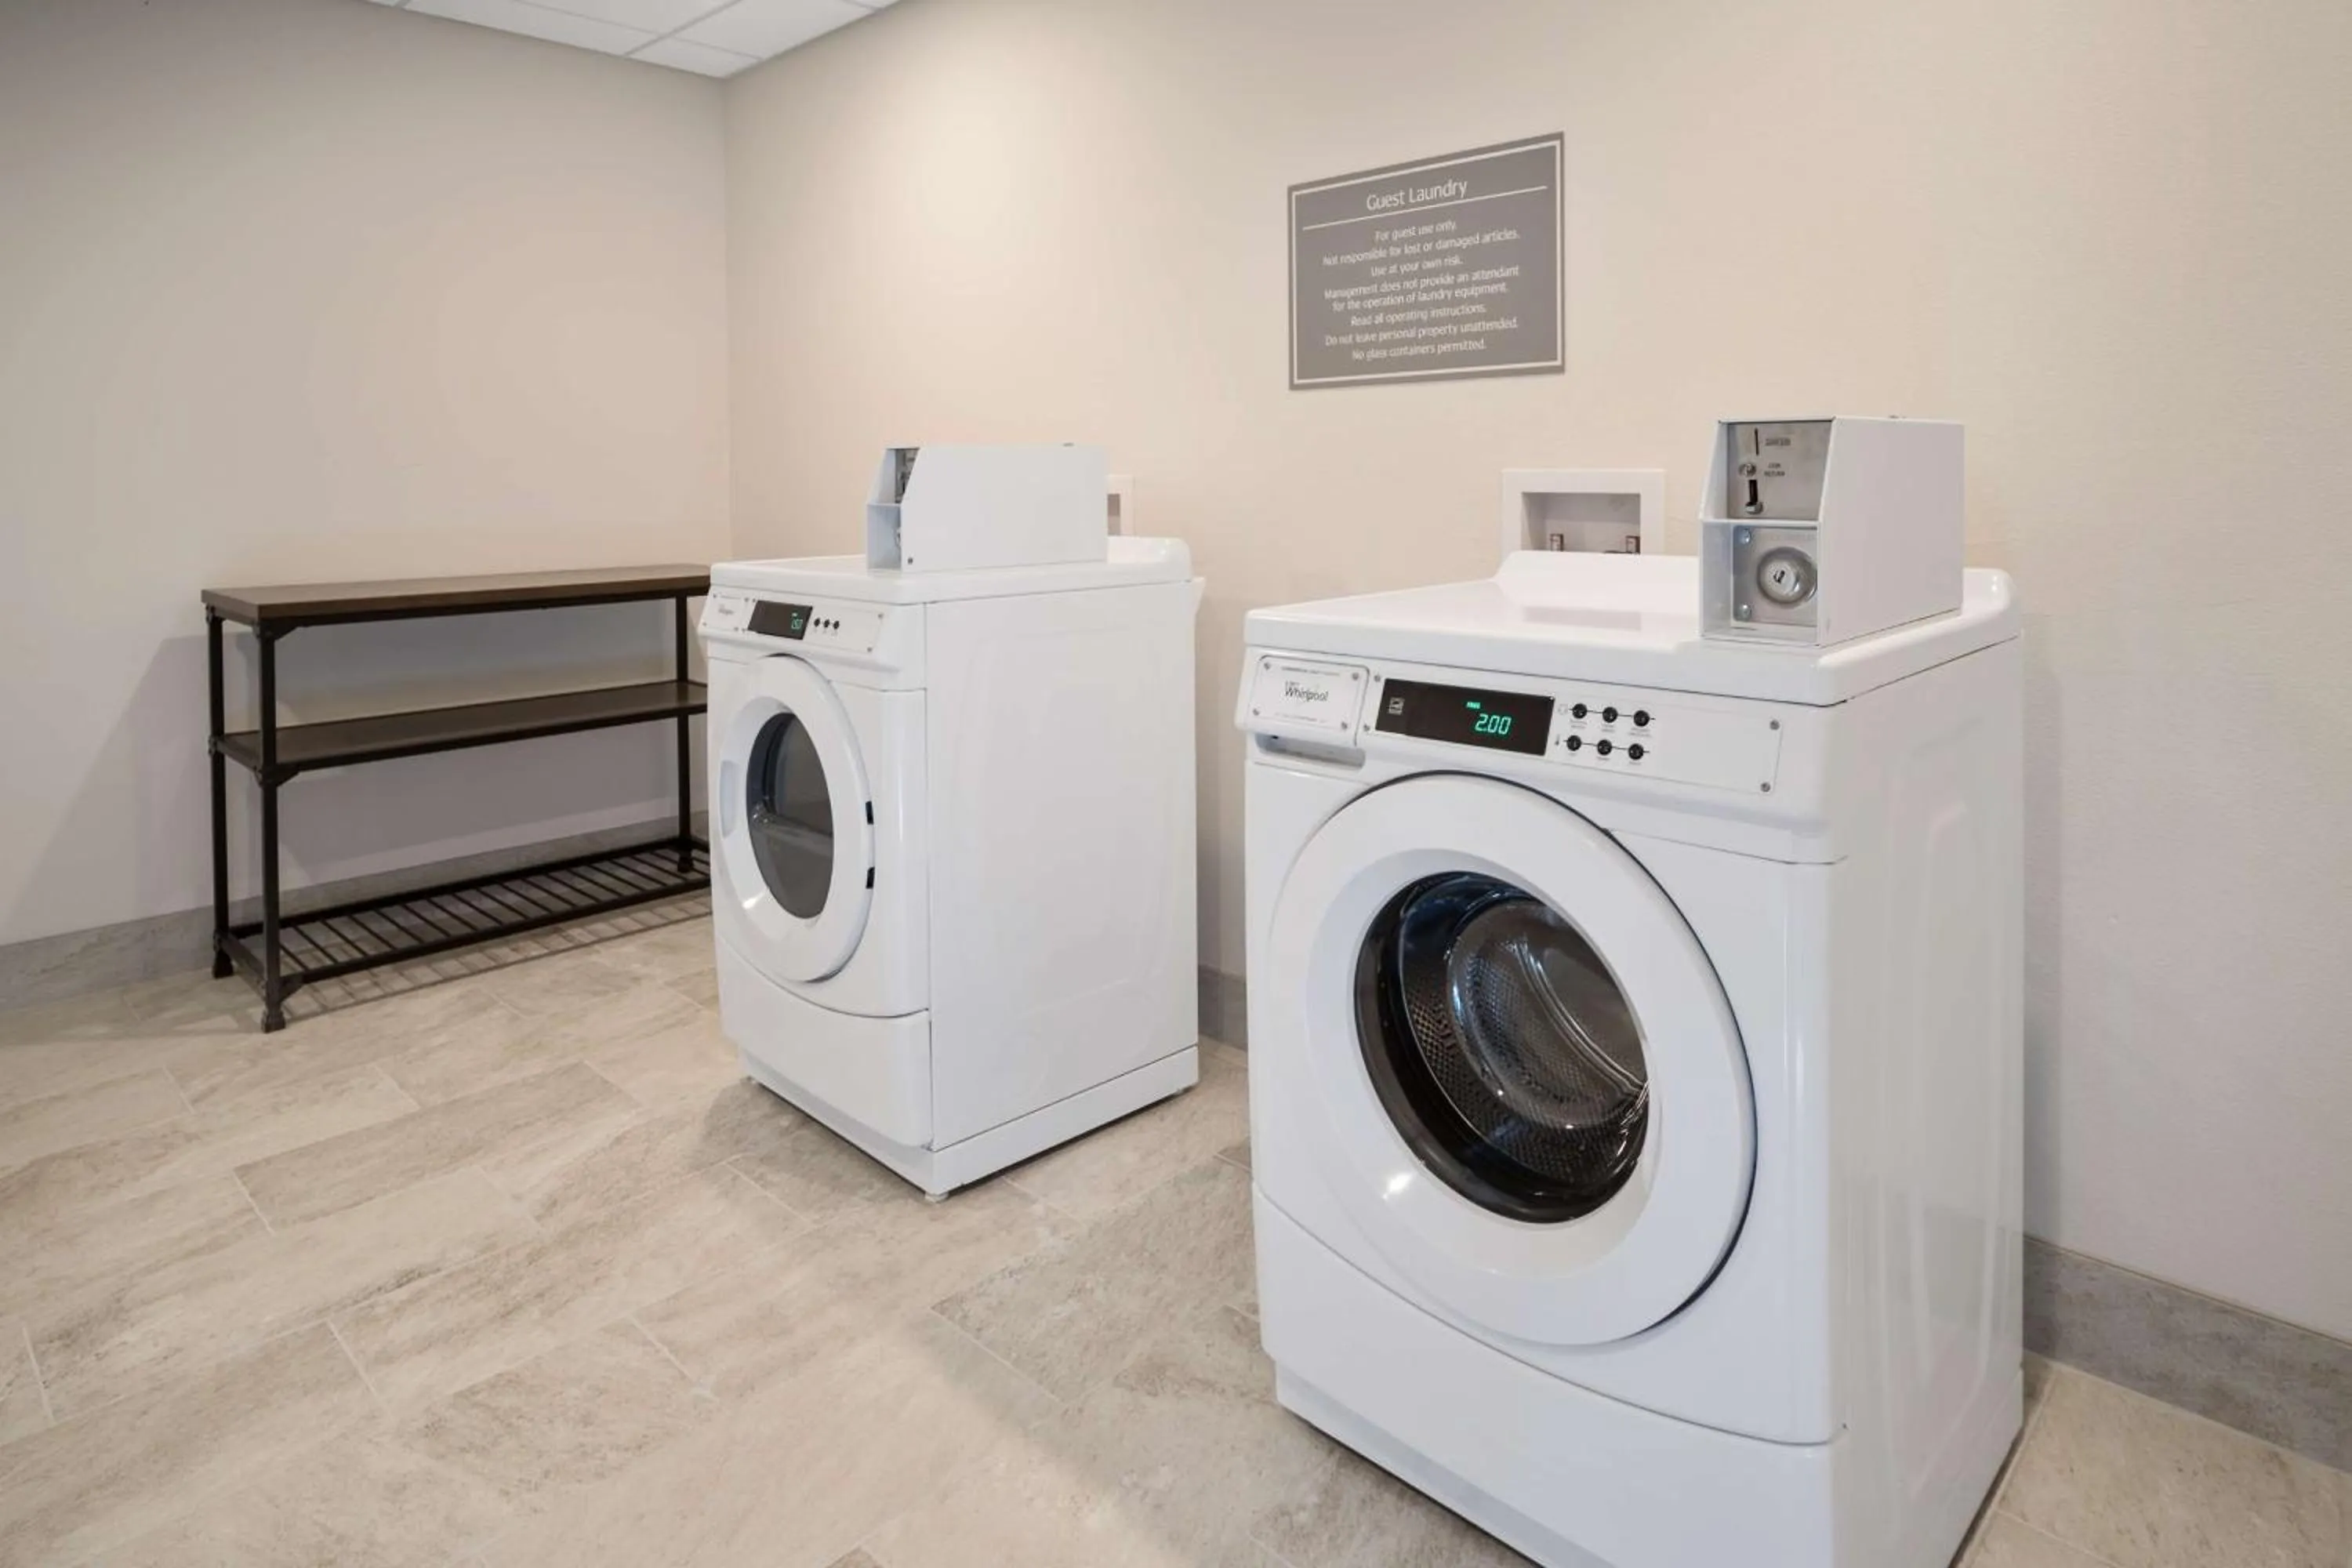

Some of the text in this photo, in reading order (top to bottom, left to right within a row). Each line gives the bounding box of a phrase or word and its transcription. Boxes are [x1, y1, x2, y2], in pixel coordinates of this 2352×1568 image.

[1367, 180, 1468, 211] Guest Laundry
[1375, 220, 1457, 241] For guest use only.
[1323, 227, 1519, 266] Not responsible for lost or damaged articles.
[1370, 255, 1464, 277] Use at your own risk.
[1324, 264, 1519, 300] Management does not provide an attendant
[1332, 280, 1508, 312] for the operation of laundry equipment.
[1351, 303, 1486, 326] Read all operating instructions.
[1325, 316, 1519, 347] Do not leave personal property unattended.
[1352, 338, 1487, 361] No glass containers permitted.
[1284, 686, 1329, 702] Whirlpool
[1474, 713, 1512, 735] 2.00
